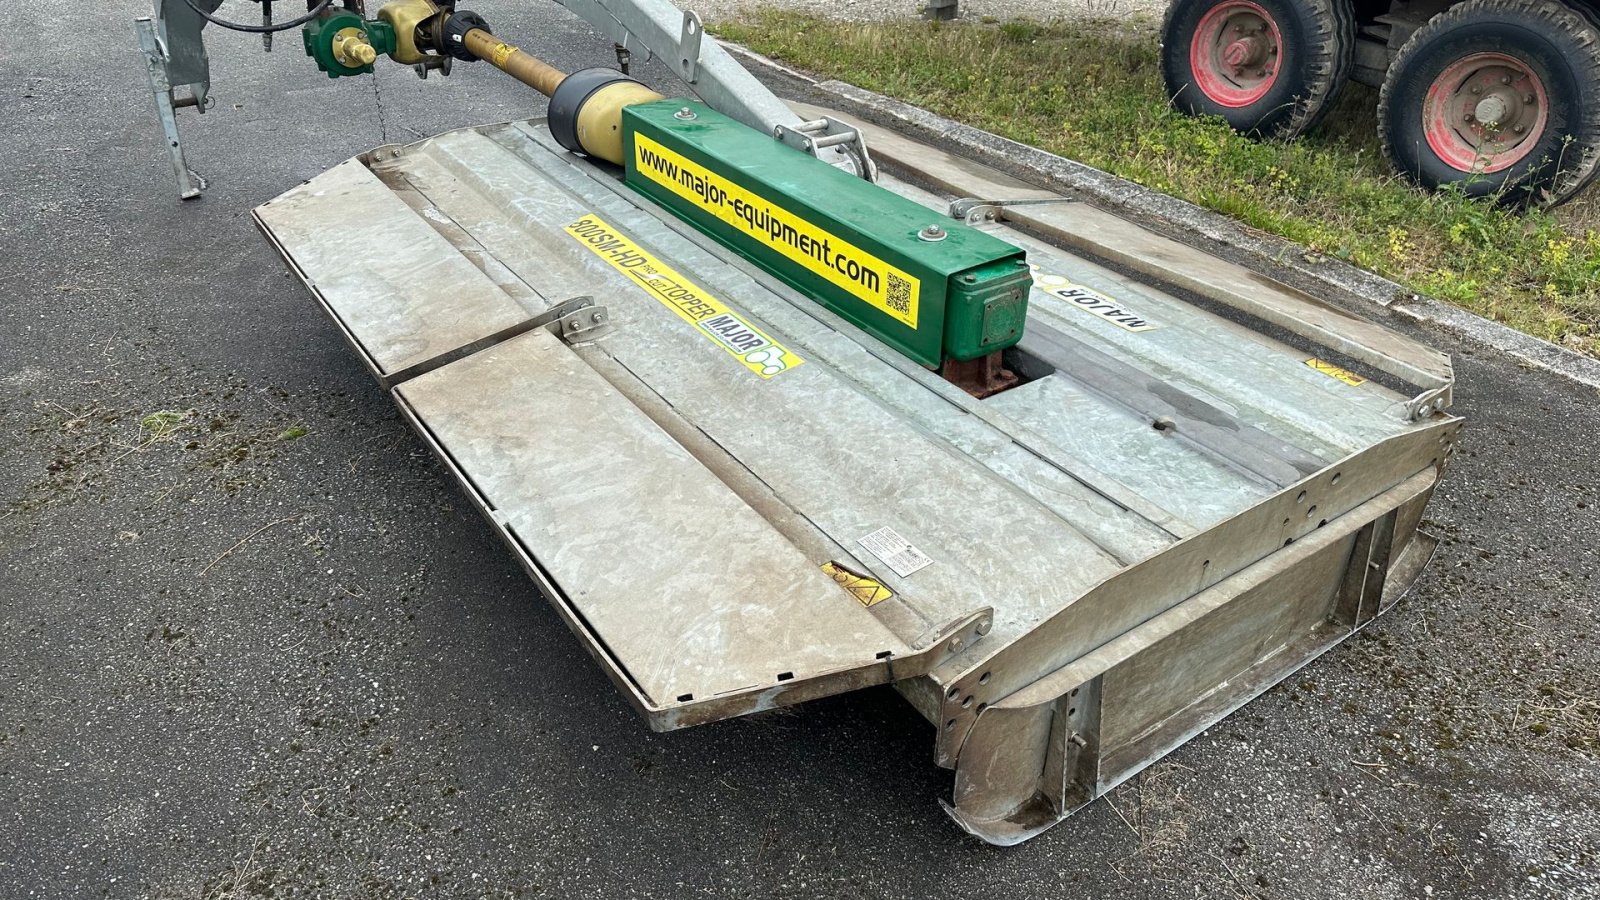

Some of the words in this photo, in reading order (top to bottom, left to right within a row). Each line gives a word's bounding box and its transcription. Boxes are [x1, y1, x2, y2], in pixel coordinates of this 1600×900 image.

[638, 144, 880, 293] www.major-equipment.com
[569, 219, 648, 268] 800SM-HD
[648, 278, 668, 290] CUT
[665, 282, 718, 320] TOPPER
[706, 314, 765, 351] MAJOR
[1057, 289, 1147, 328] MAJOR
